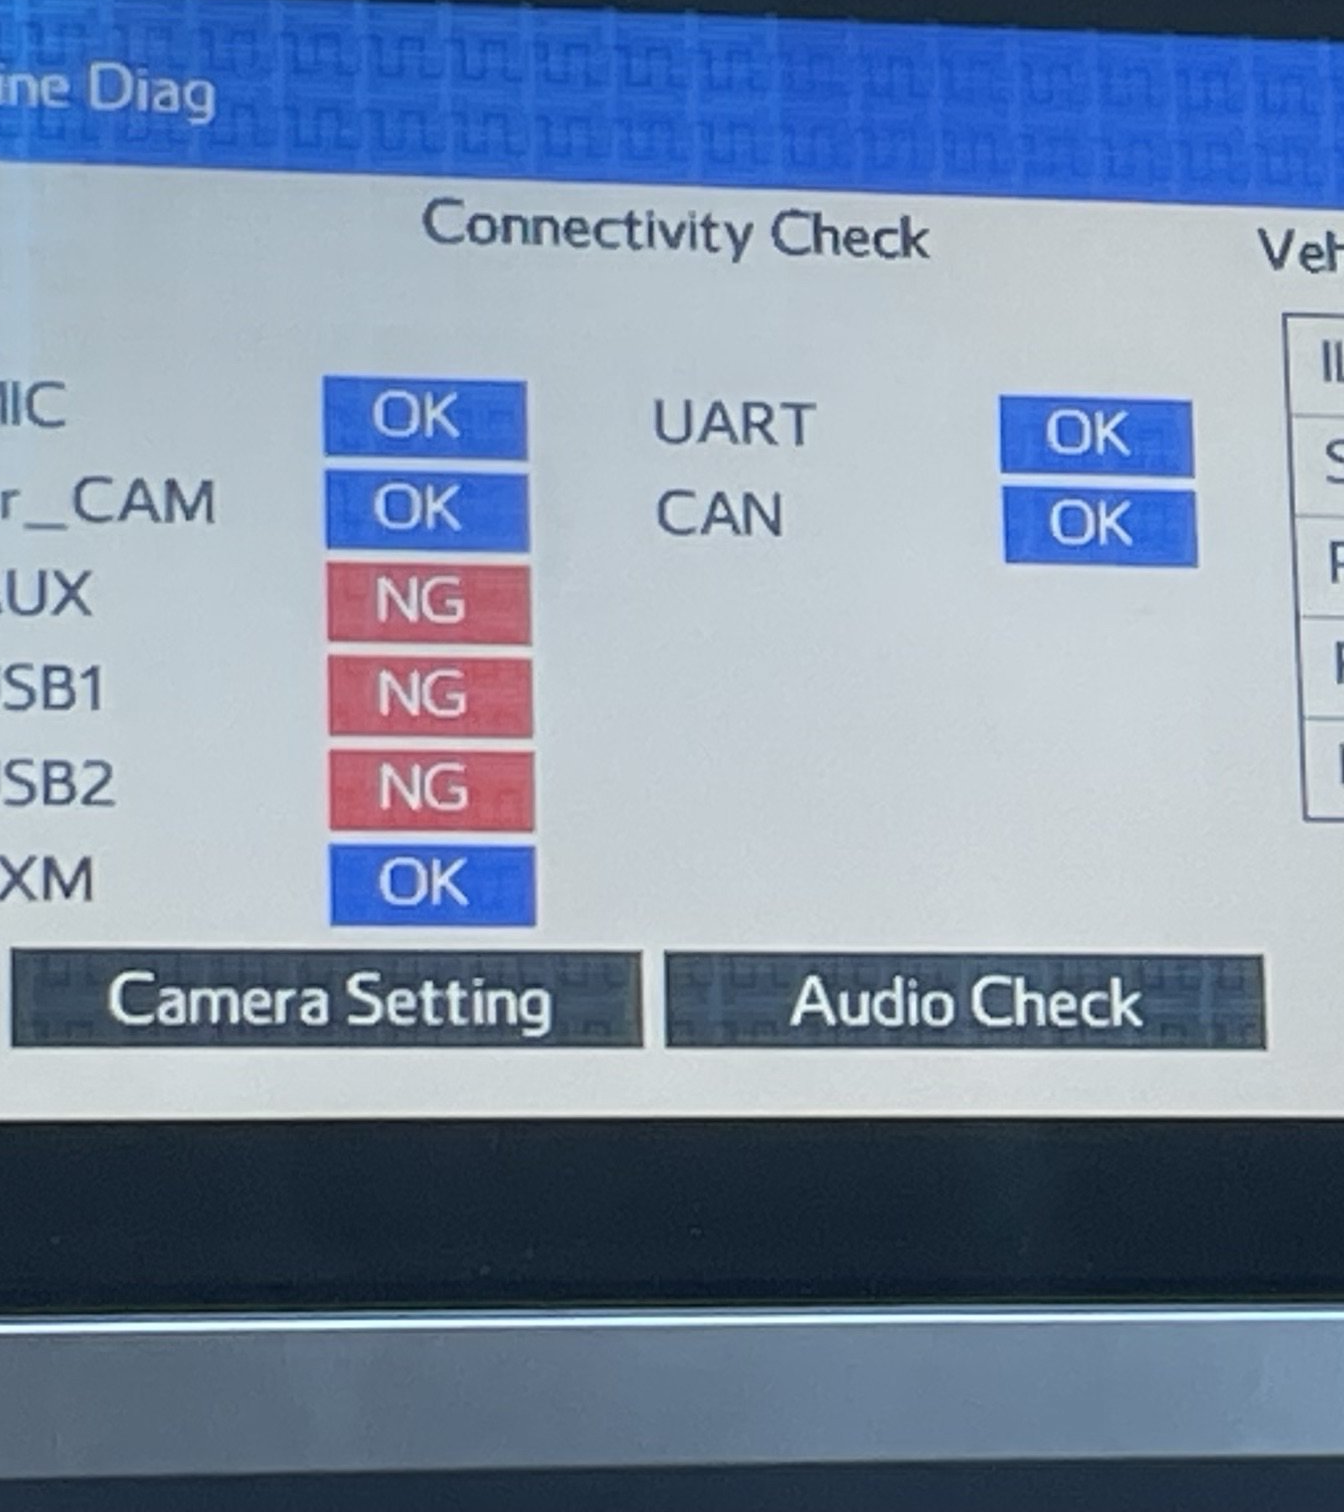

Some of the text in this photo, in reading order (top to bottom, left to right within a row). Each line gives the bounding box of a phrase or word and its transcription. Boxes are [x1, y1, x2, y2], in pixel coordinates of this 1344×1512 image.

[89, 61, 216, 125] Diag
[422, 196, 931, 262] Connectivity Check
[372, 388, 461, 440] OK
[653, 400, 817, 447] UART
[1045, 409, 1129, 454] OK
[372, 482, 463, 533] OK
[657, 490, 783, 538] CAN
[1049, 499, 1133, 545] OK
[375, 574, 466, 625] NG
[376, 668, 468, 718] NG
[377, 763, 469, 811] NG
[378, 858, 469, 907] OK
[108, 971, 552, 1036] Camera Setting
[790, 976, 1144, 1027] Audio Check
